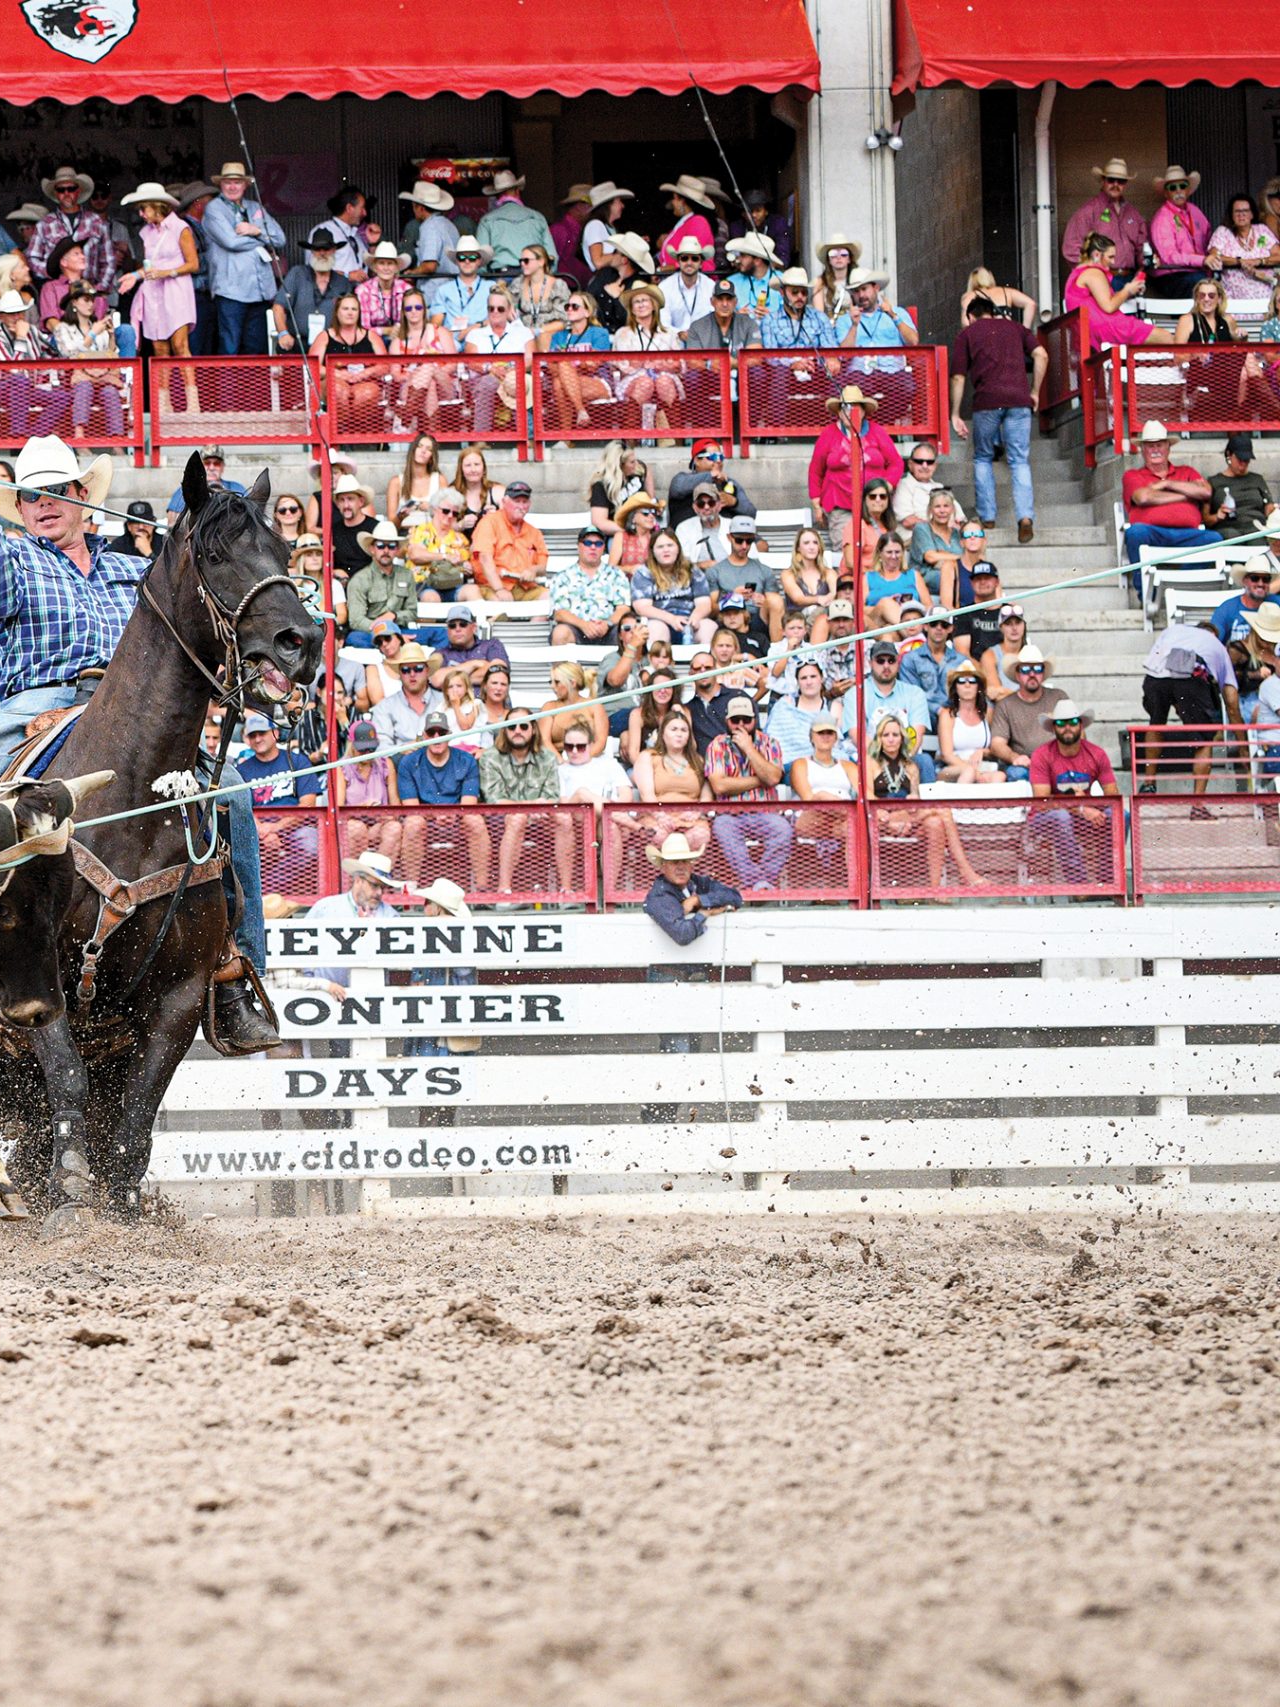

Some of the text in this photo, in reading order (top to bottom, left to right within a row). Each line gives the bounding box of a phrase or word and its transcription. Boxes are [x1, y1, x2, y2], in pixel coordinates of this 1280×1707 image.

[265, 924, 563, 956] EYENNE
[283, 994, 565, 1027] ONTIER
[285, 1066, 463, 1098] DAYS
